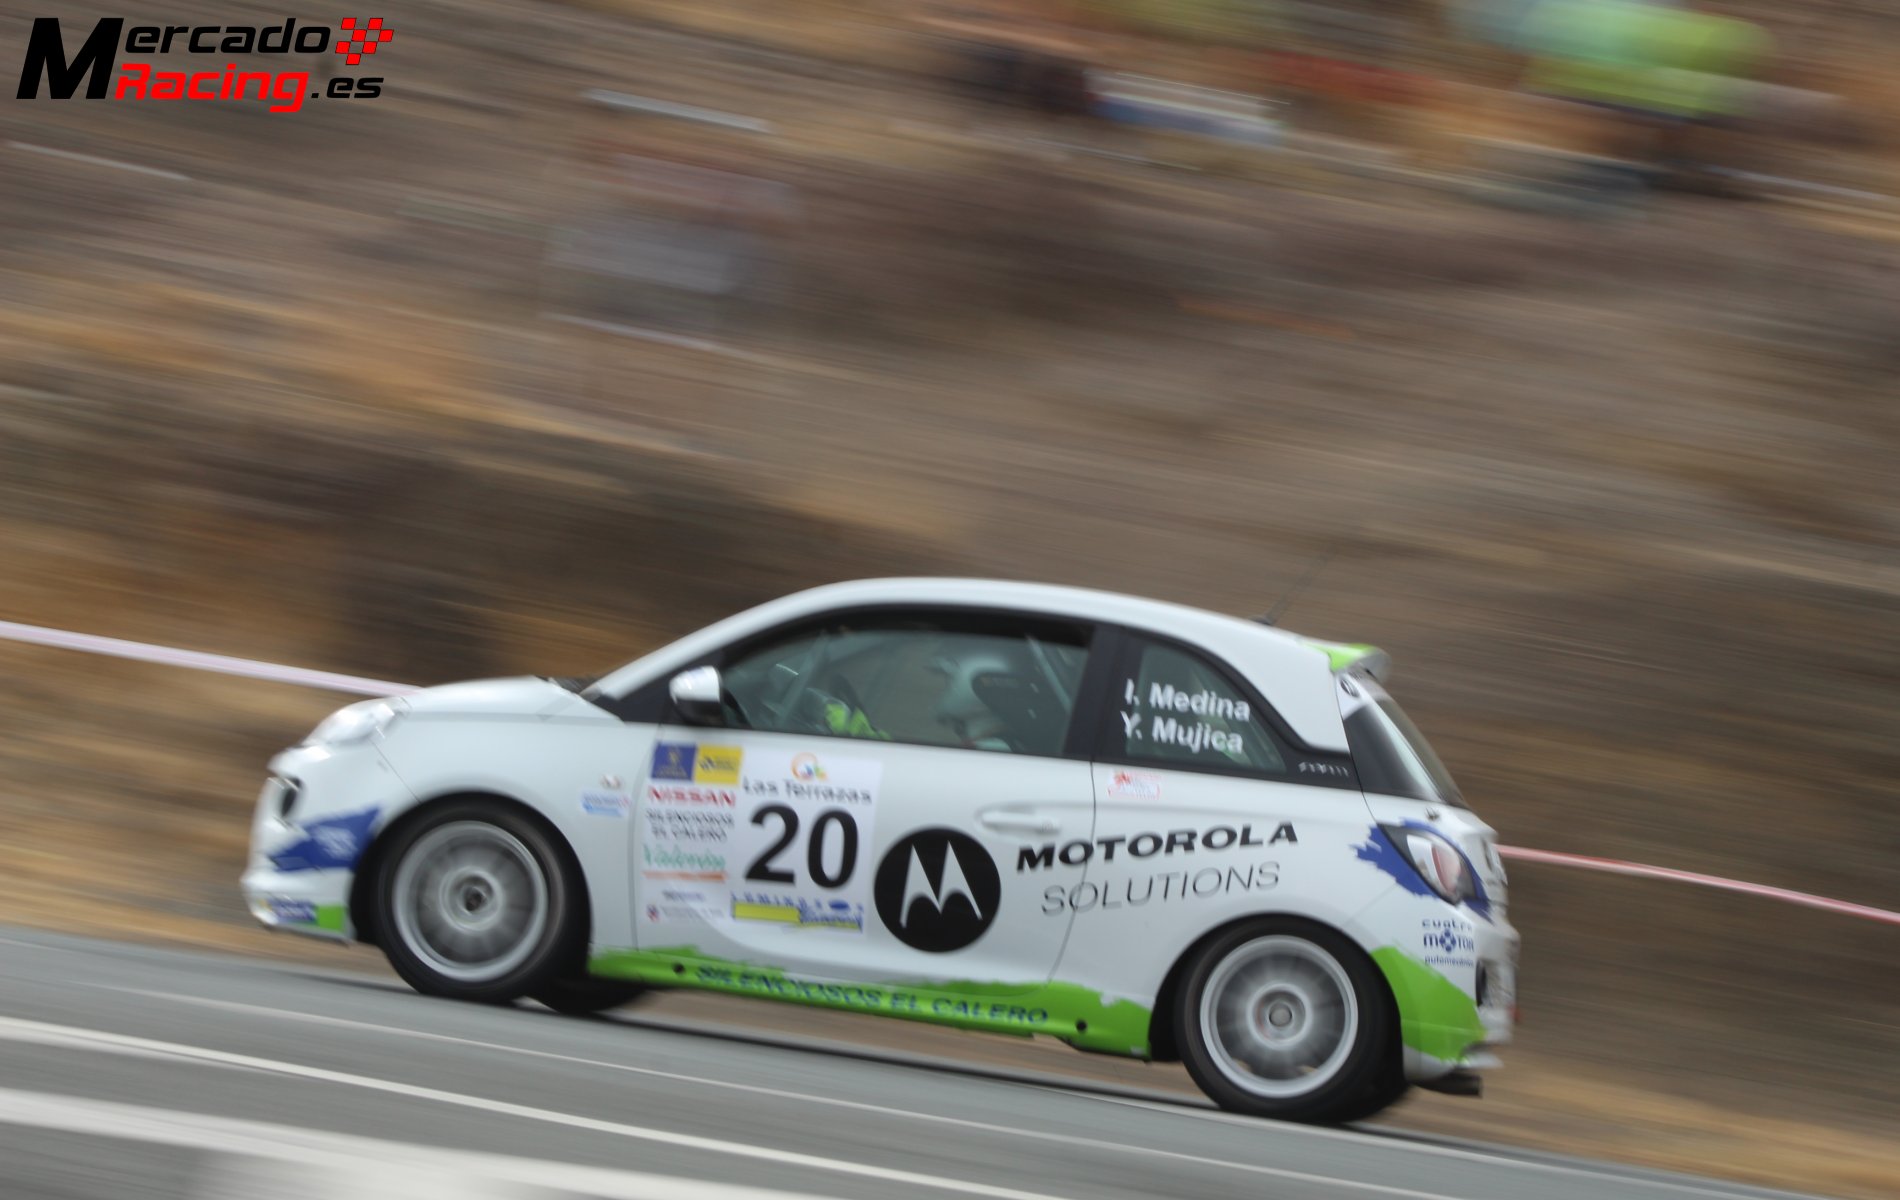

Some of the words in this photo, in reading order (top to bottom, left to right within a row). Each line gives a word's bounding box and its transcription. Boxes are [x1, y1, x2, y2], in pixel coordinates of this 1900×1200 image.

[1149, 682, 1251, 723] Medina
[1151, 715, 1244, 753] Mujica
[648, 785, 737, 808] NISSAN
[743, 776, 779, 797] Las
[783, 778, 873, 806] Terrazas
[744, 801, 860, 891] 20
[1016, 821, 1299, 873] MOTOROLA
[1041, 861, 1281, 917] SOLUTIONS
[696, 966, 882, 1009] SILENCIOSOS
[890, 993, 923, 1012] EL
[931, 996, 1049, 1026] CALERO
